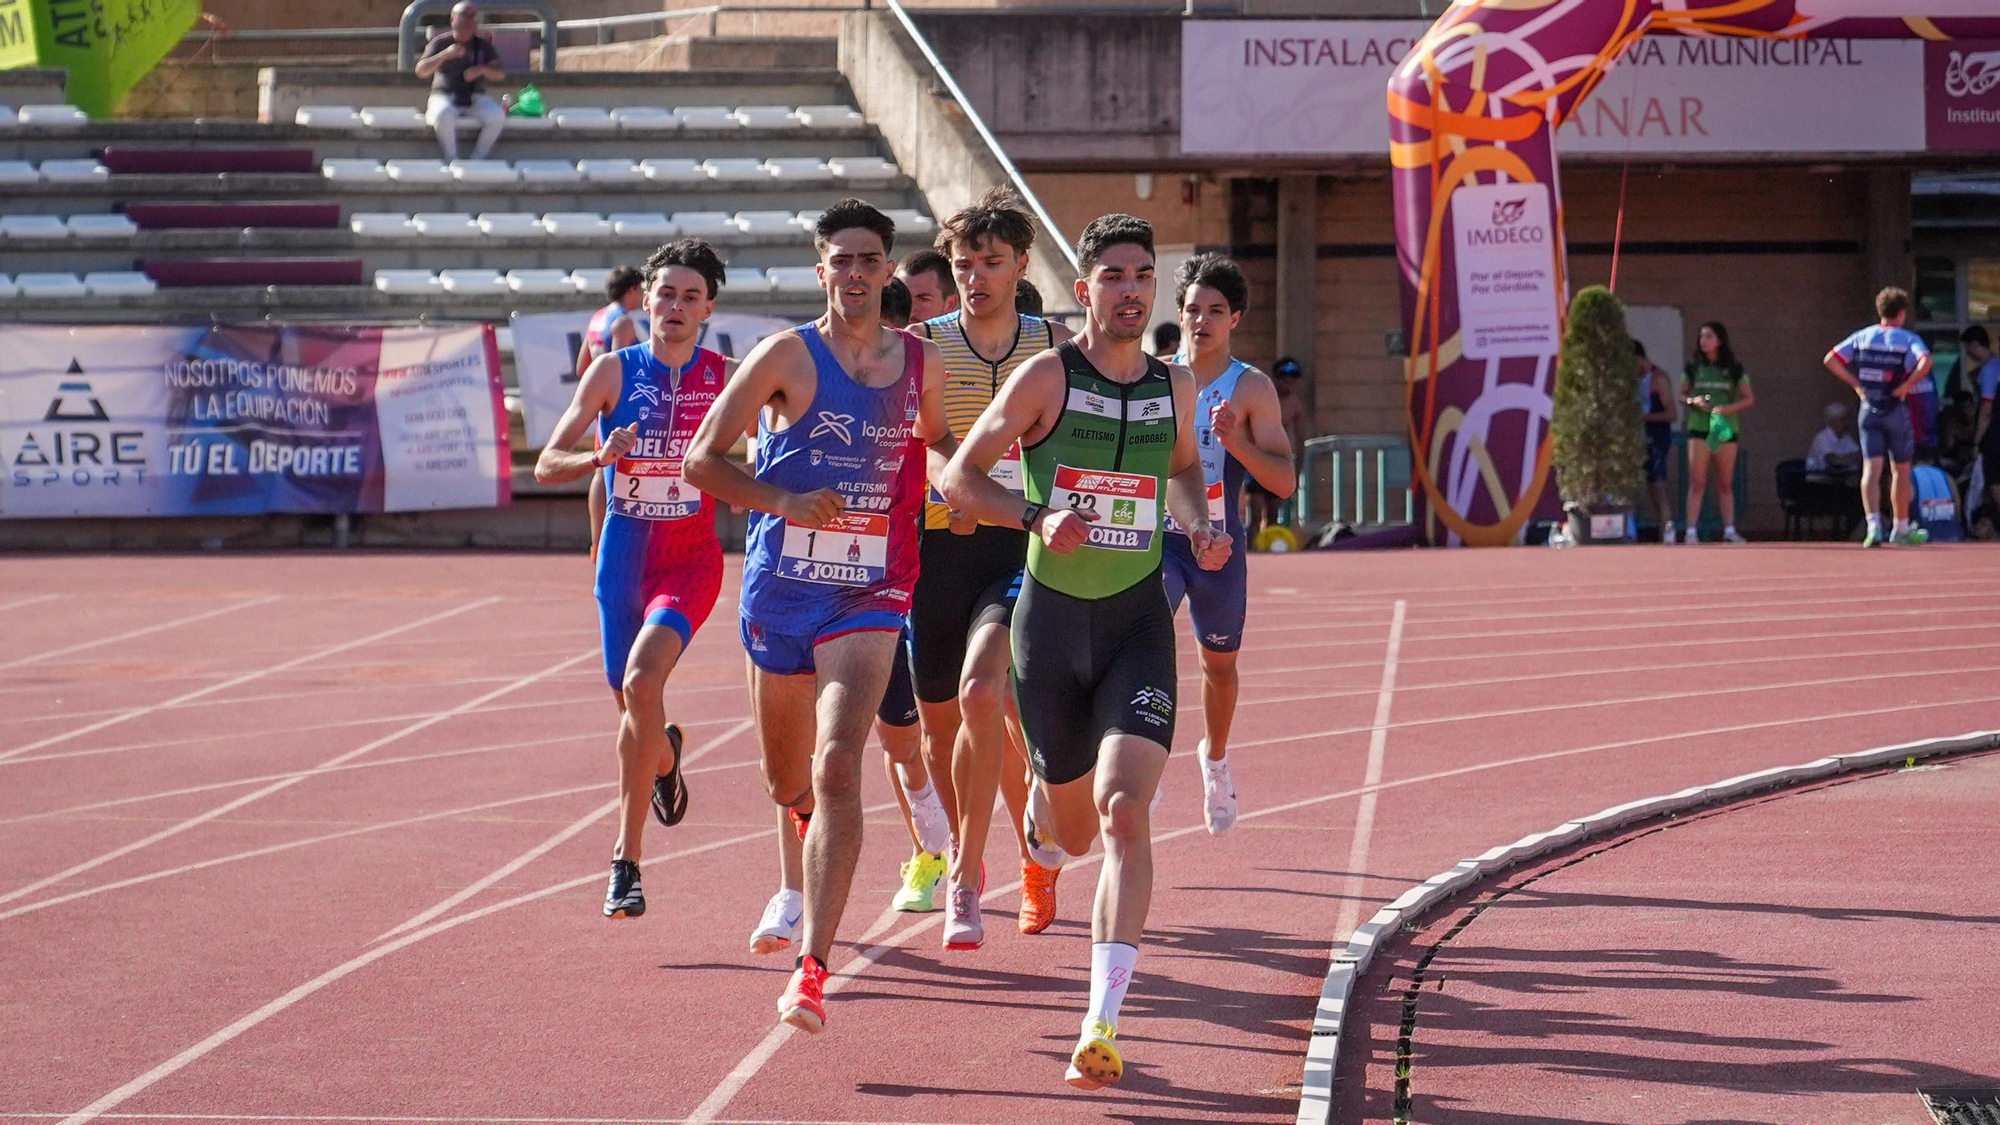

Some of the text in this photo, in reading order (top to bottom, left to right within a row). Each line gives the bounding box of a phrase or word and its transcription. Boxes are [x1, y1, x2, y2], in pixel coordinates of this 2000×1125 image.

[1677, 37, 1861, 67] MUNICIPAL
[1467, 226, 1543, 246] IMDECO
[1470, 271, 1490, 282] Por
[1471, 284, 1490, 294] Por
[164, 357, 263, 388] NOSOTROS
[266, 364, 358, 395] PONEMOS
[194, 389, 329, 425] LA EQUIPACIÓN
[1071, 428, 1168, 445] ATLETISMO CORDOBÉS
[13, 431, 146, 466] AIRE
[169, 438, 201, 476] TÚ
[207, 442, 240, 476] EL
[824, 454, 859, 463] Ayuntamiento
[13, 468, 148, 487] SPORT
[628, 477, 640, 498] 2
[836, 481, 888, 493] ATLETISMO
[1100, 476, 1141, 488] RFEA
[1113, 509, 1133, 519] CAC
[807, 531, 816, 557] 1
[1088, 527, 1139, 547] oma
